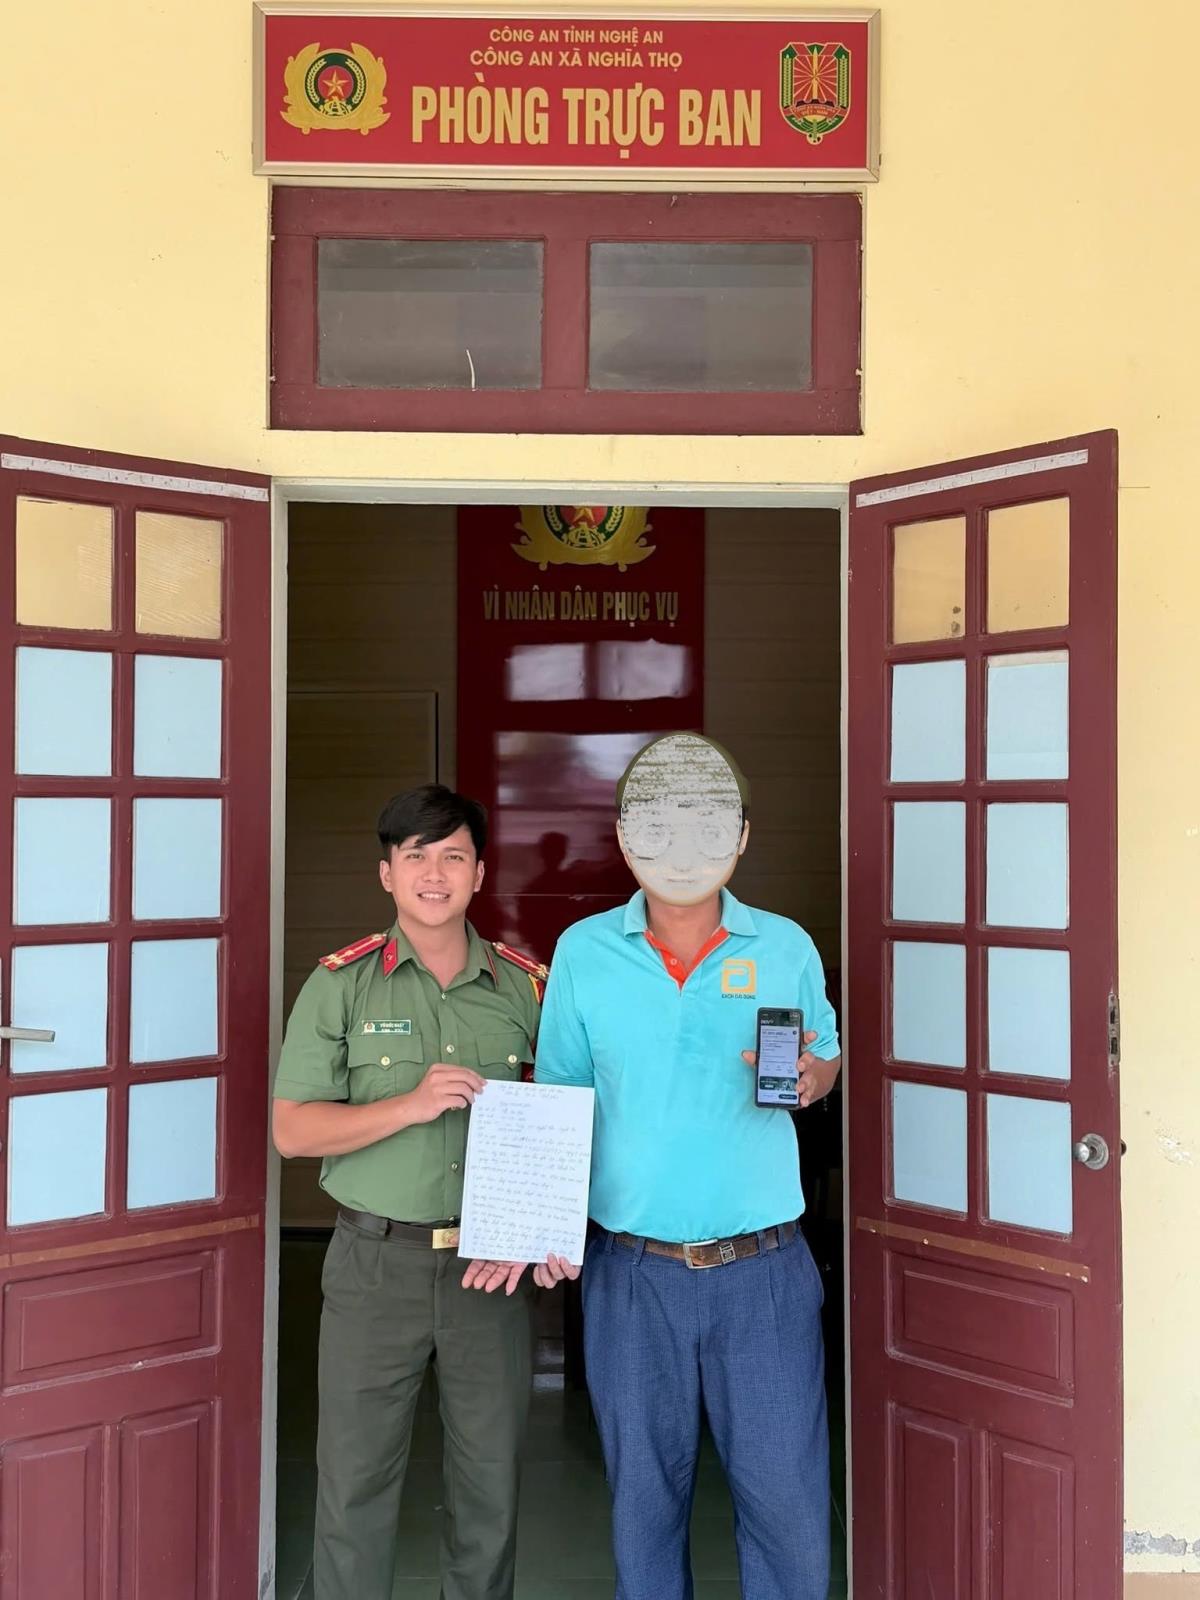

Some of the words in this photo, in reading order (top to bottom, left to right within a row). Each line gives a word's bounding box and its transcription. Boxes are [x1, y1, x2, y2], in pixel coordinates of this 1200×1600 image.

[490, 25, 534, 42] CÔNG
[538, 29, 559, 43] AN
[563, 25, 595, 43] TỈNH
[599, 27, 638, 47] NGHỆ
[642, 30, 664, 44] AN
[470, 46, 524, 66] CÔNG
[528, 51, 553, 66] AN
[558, 47, 583, 67] XÃ
[587, 48, 644, 68] NGHĨA
[648, 52, 683, 72] THỌ
[411, 71, 549, 145] PHÒNG
[562, 82, 665, 159] TRỰC
[679, 88, 762, 147] BAN
[482, 584, 500, 620] VÌ
[505, 584, 555, 620] NHÂN
[560, 584, 597, 620] DÂN
[602, 591, 650, 628] PHỤC
[655, 591, 679, 628] VỤ
